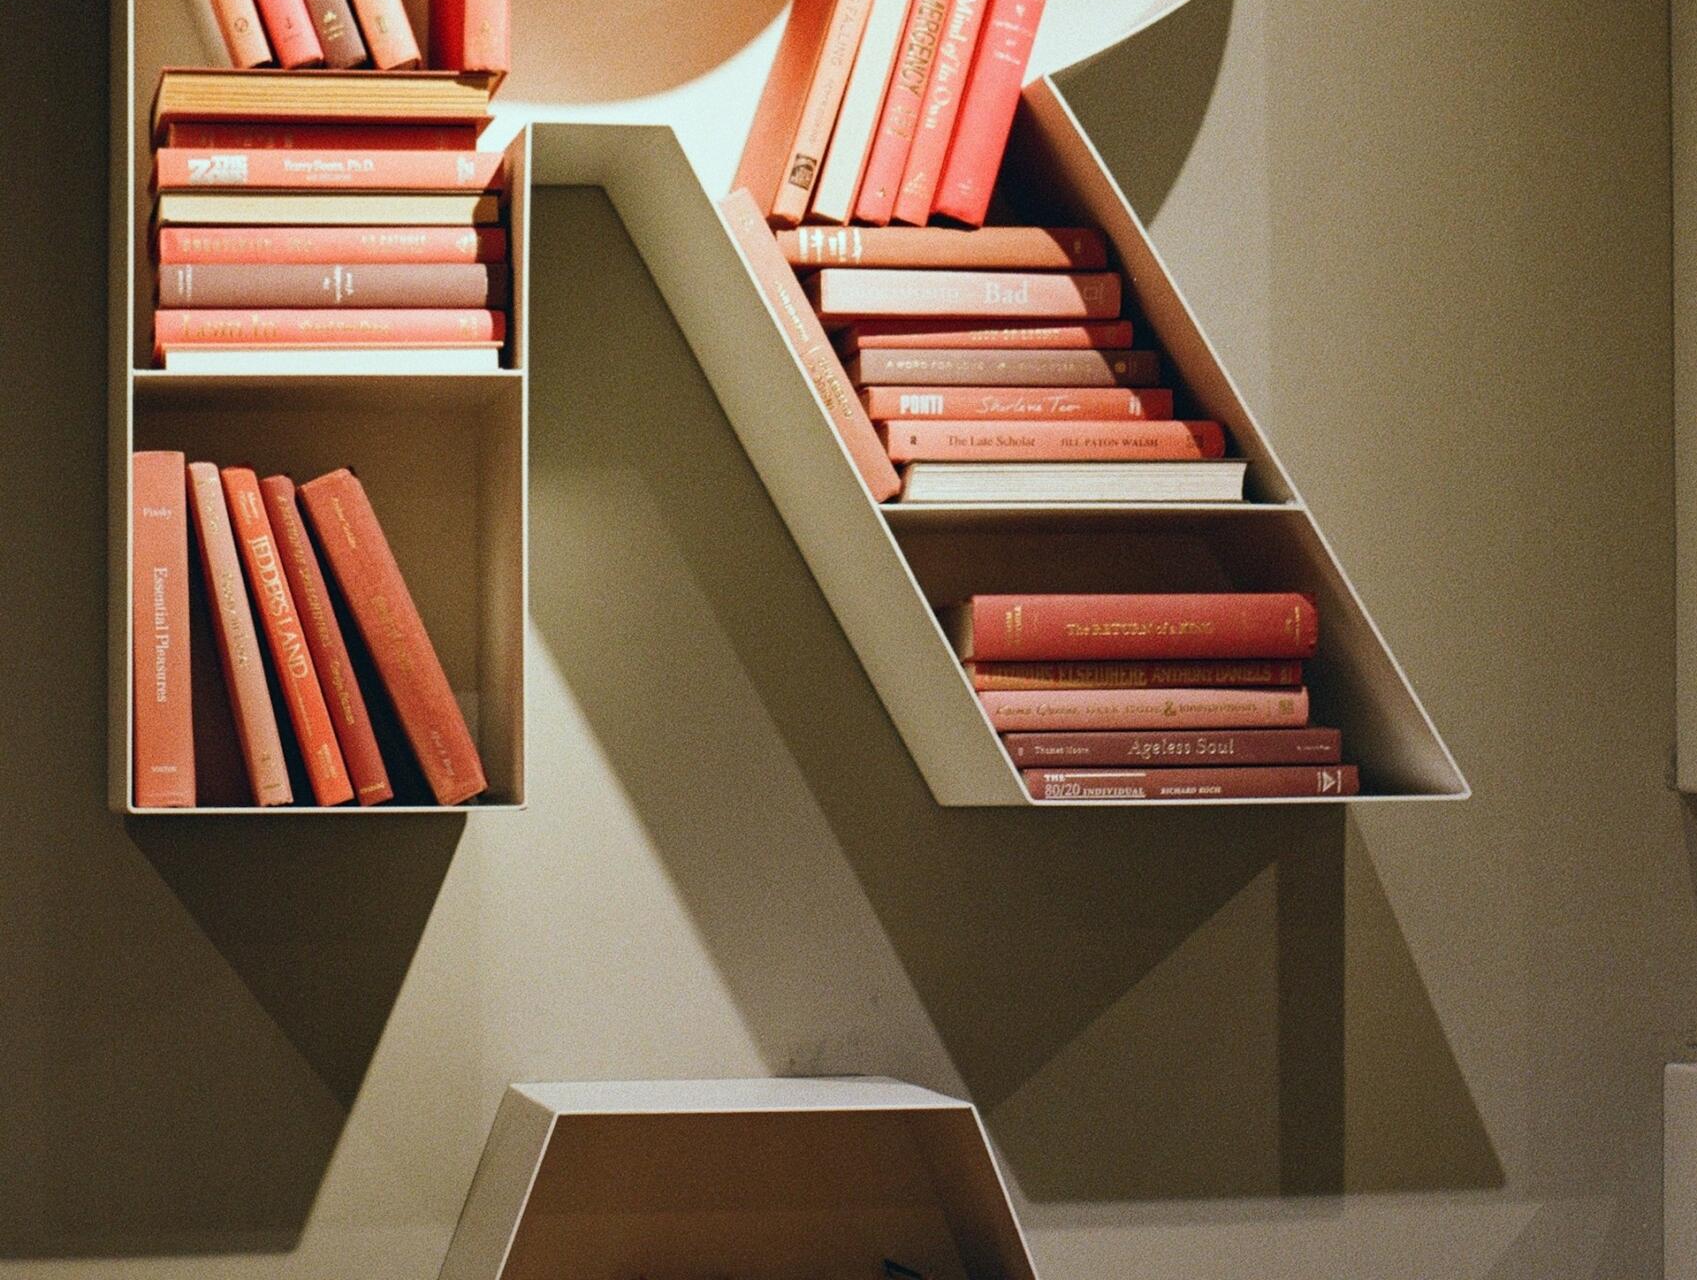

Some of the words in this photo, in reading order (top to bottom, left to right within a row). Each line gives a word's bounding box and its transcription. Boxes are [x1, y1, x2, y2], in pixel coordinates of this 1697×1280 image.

[830, 6, 858, 67] FALLING
[938, 41, 964, 62] of
[925, 86, 951, 130] Own
[983, 279, 1030, 306] Bad
[899, 394, 945, 415] PONTI
[947, 434, 967, 448] The
[969, 434, 993, 448] Late
[994, 434, 1036, 448] Scholar
[1060, 436, 1081, 448] JILL
[1083, 437, 1120, 448] PATON
[1121, 437, 1159, 448] WALSH
[153, 566, 169, 631] Essential
[1066, 623, 1091, 636] The
[1092, 623, 1151, 636] RETURN
[275, 617, 309, 681] LAND
[153, 635, 170, 704] Pleasures
[1163, 700, 1177, 716] &
[1127, 739, 1190, 760] Ageless
[1195, 738, 1235, 755] Soul
[1045, 783, 1081, 797] 80/20
[1083, 786, 1146, 797] INDIVIDUAL
[1161, 786, 1196, 795] RICHARD
